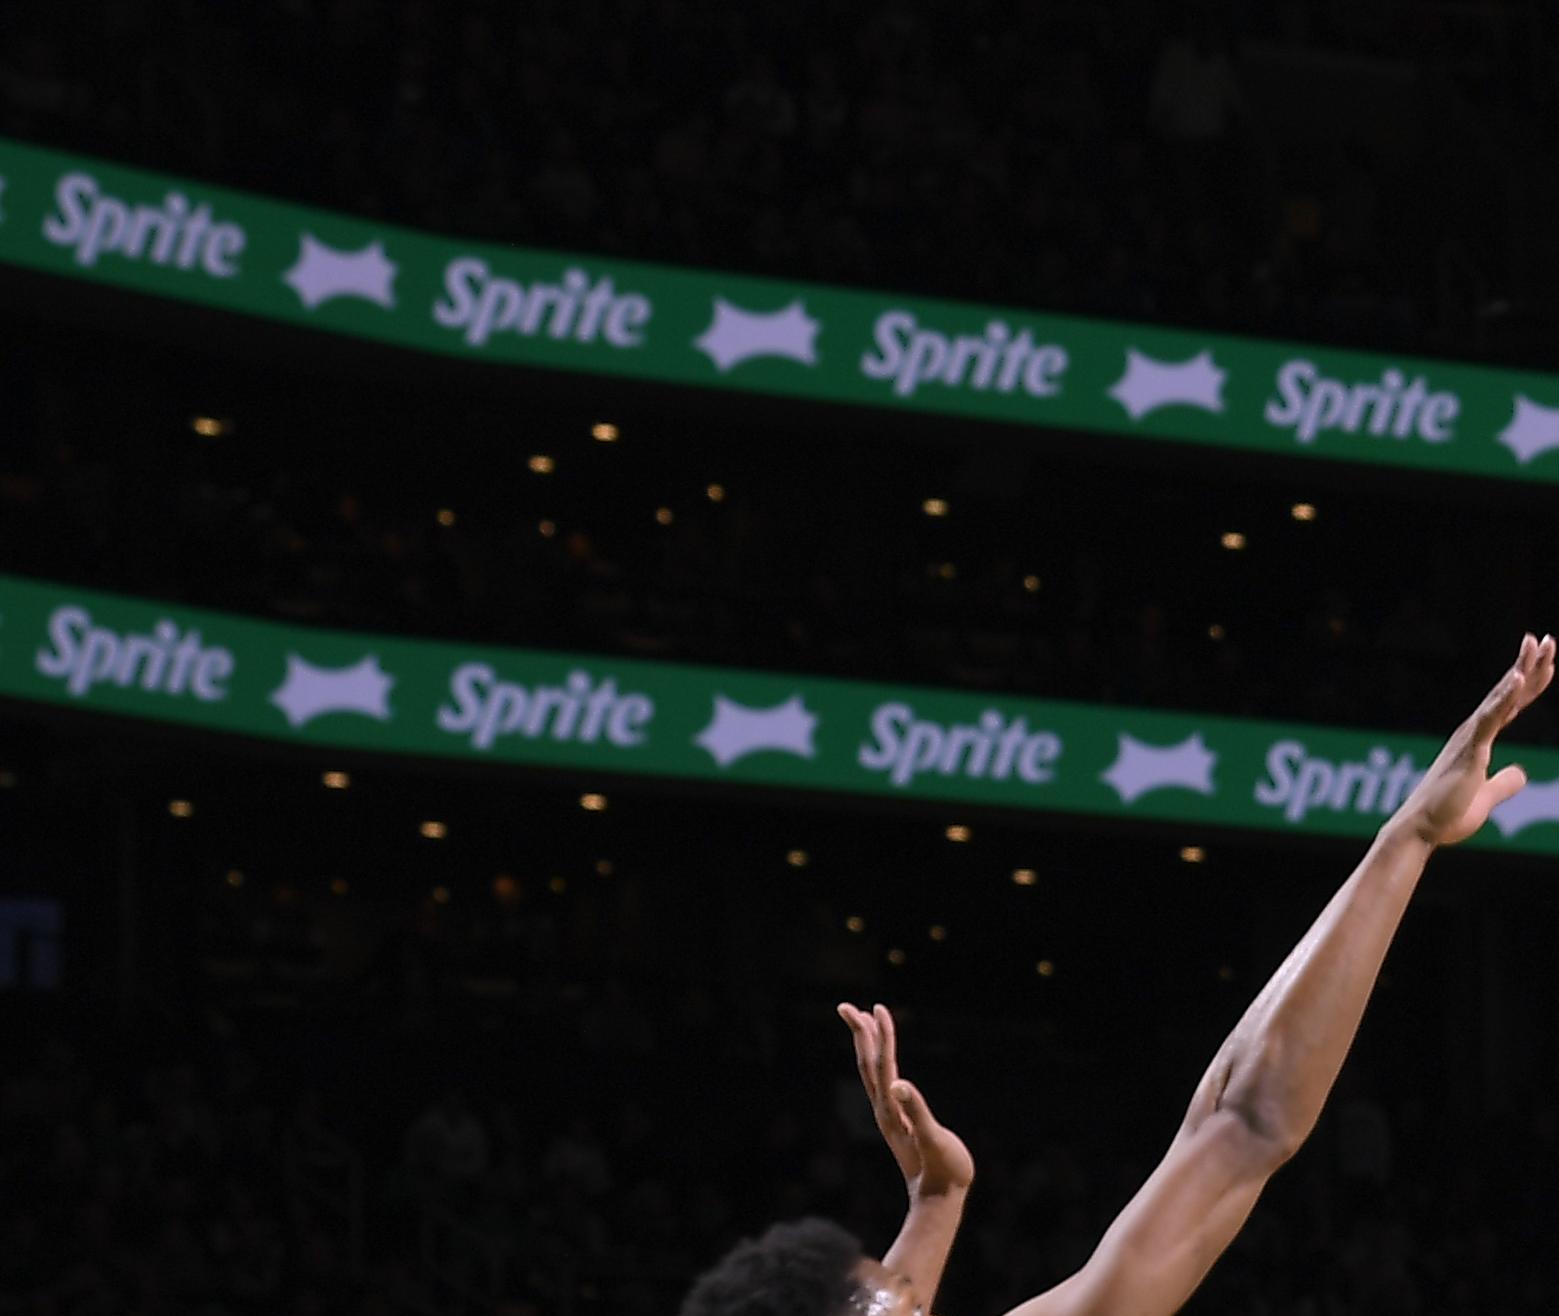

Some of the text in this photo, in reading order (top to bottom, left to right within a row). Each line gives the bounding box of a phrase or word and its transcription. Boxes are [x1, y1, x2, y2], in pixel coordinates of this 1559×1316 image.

[41, 169, 249, 281] Sprite
[433, 257, 651, 348] Sprite
[860, 310, 1068, 397] Sprite
[1264, 359, 1460, 444] Sprite
[34, 603, 236, 702] Sprite
[437, 663, 654, 750] Sprite
[857, 701, 1061, 787] Sprite
[1253, 739, 1427, 824] Sprit
